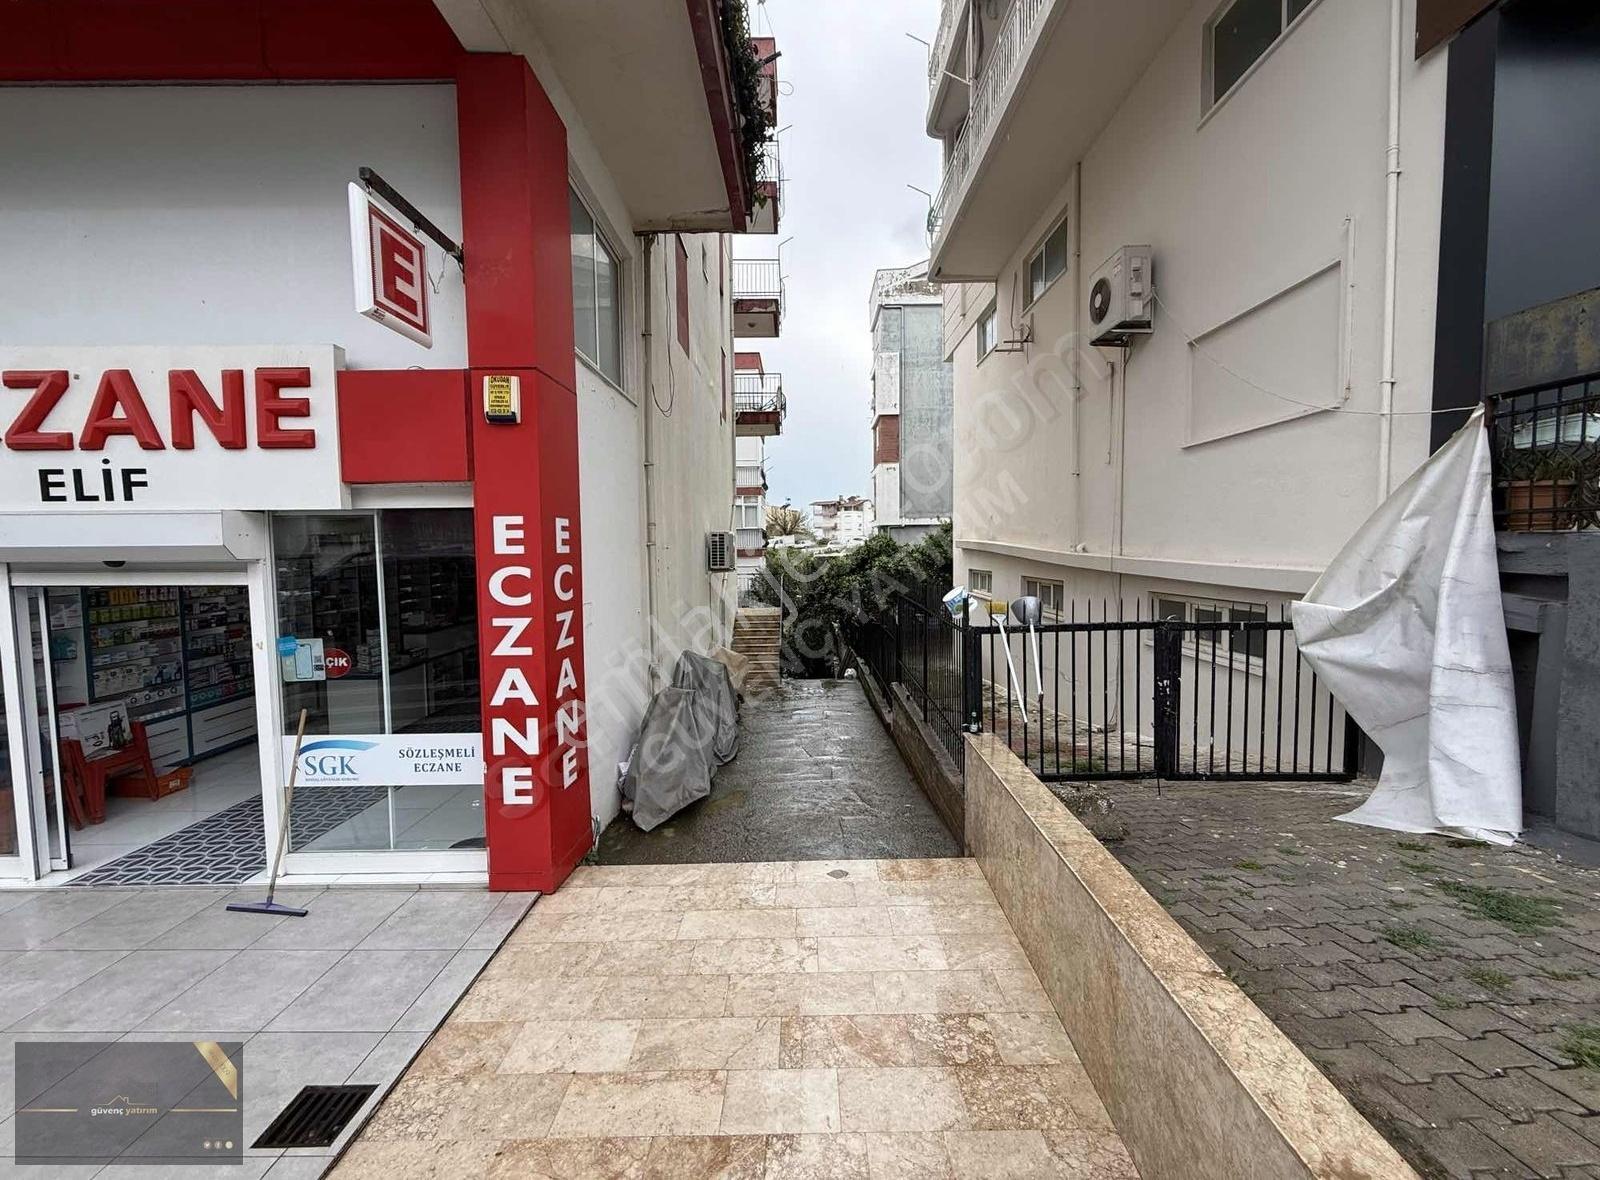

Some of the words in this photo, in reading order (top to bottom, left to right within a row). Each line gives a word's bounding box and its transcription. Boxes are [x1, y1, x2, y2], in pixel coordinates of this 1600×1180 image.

[0, 367, 316, 450] ZANE
[38, 458, 148, 502] ELİF
[324, 656, 349, 669] ÇIK
[488, 515, 539, 806] ECZANE
[553, 516, 579, 791] ECZANE
[304, 755, 358, 776] SGK
[398, 746, 476, 760] SÖZLEŞMELİ
[414, 763, 462, 773] ECZANE
